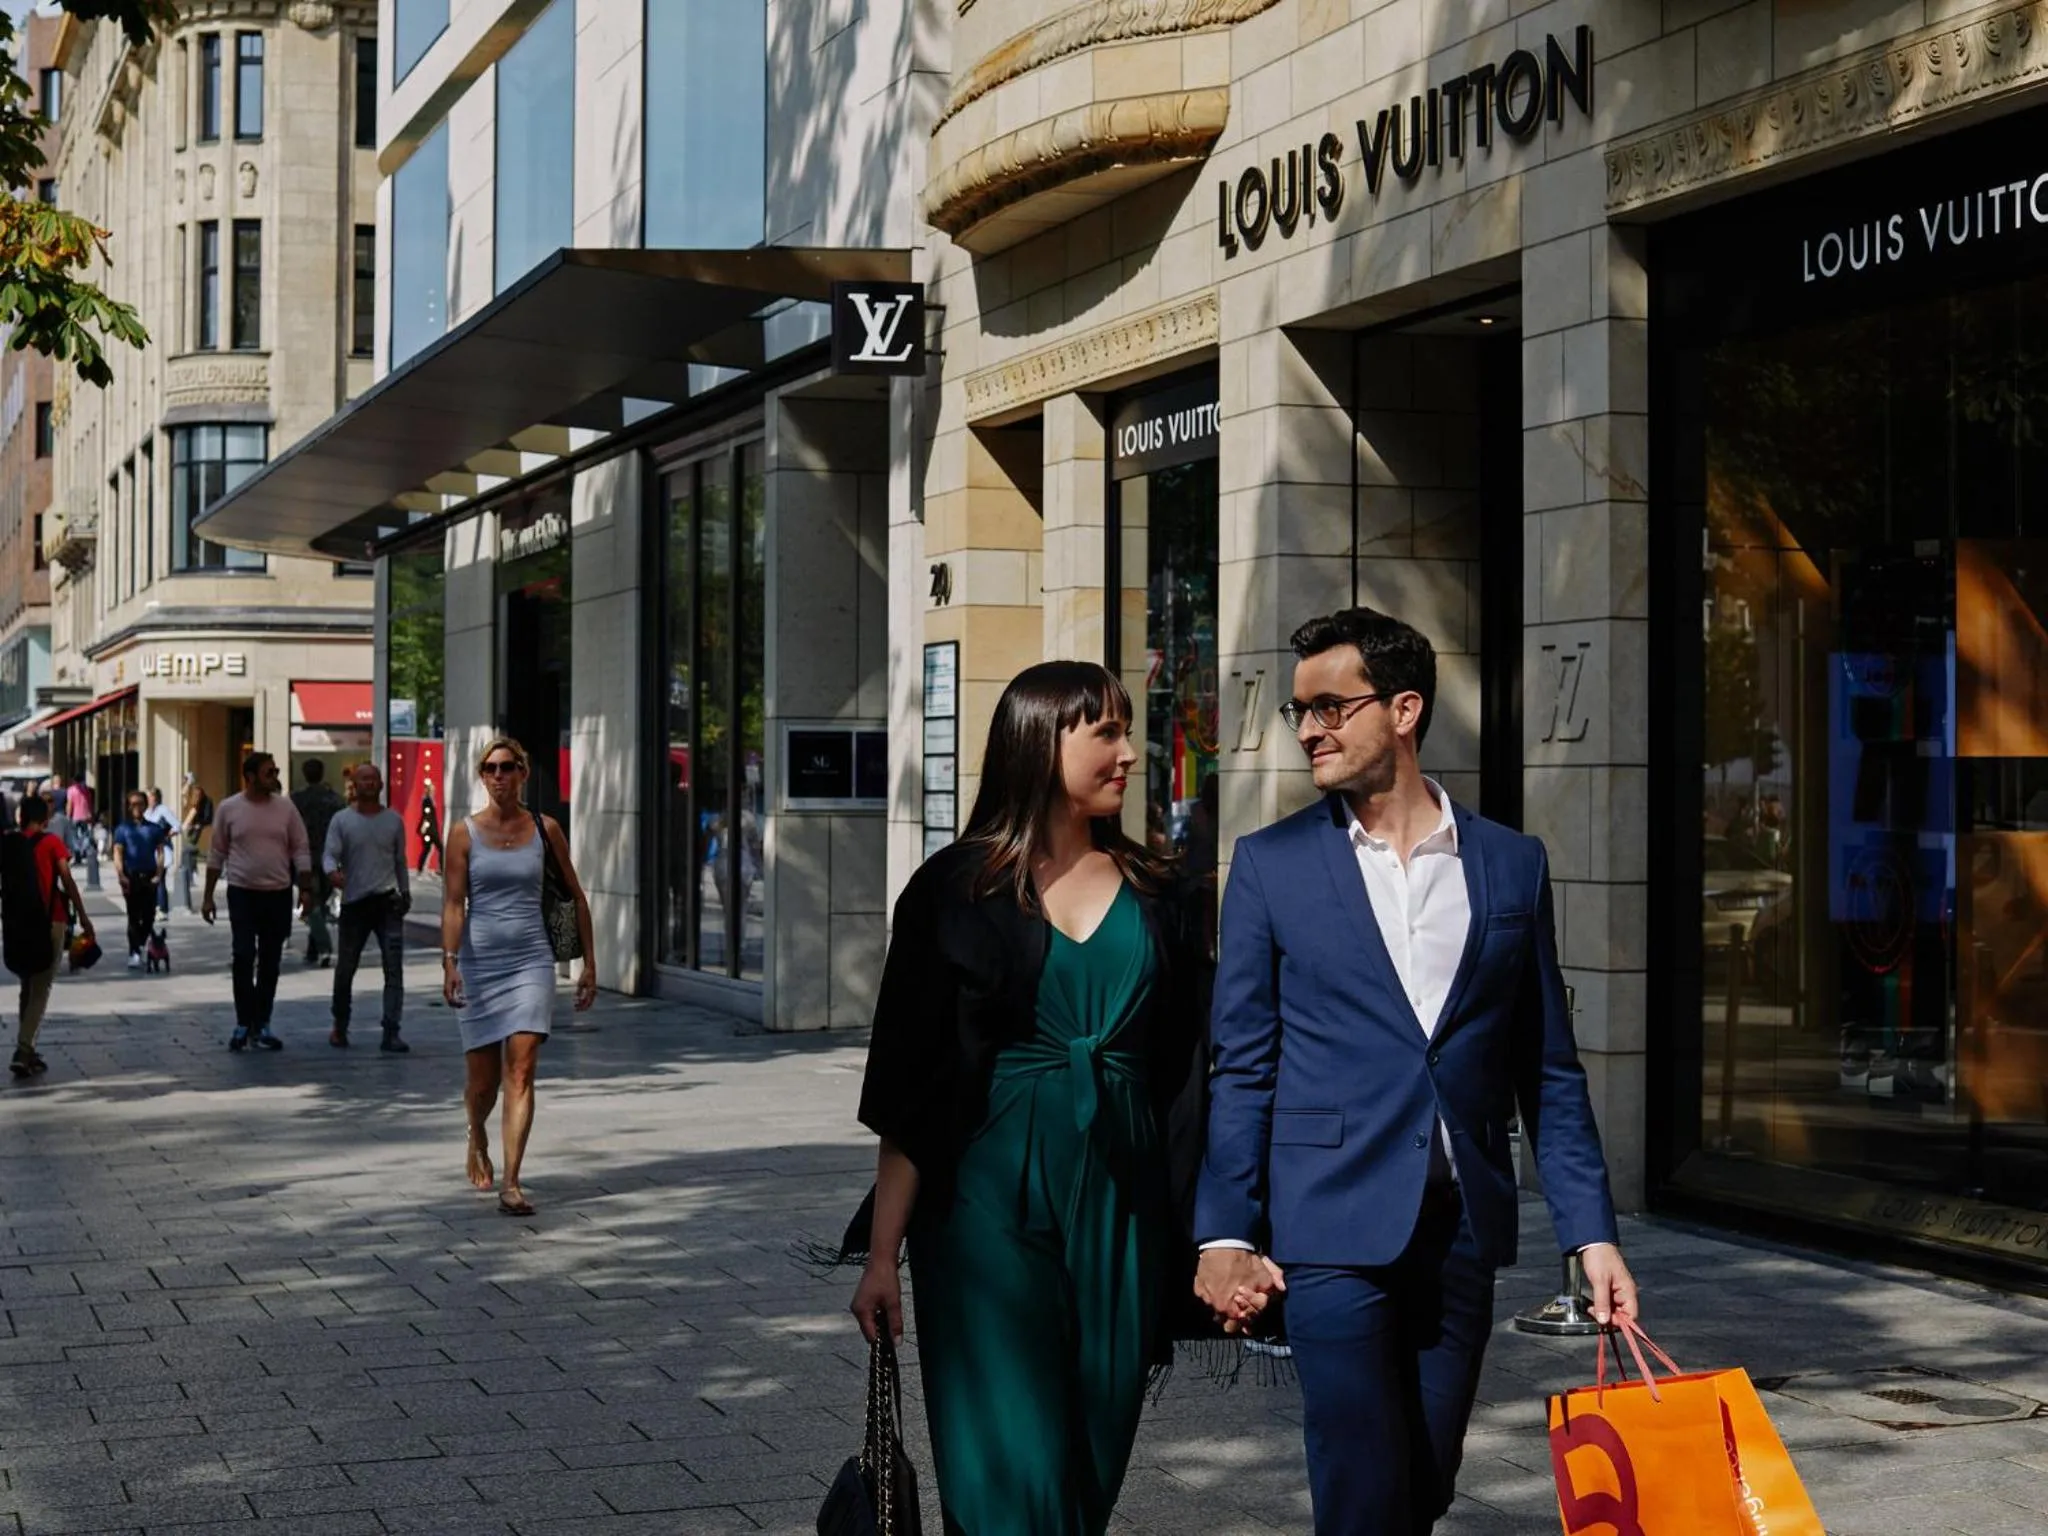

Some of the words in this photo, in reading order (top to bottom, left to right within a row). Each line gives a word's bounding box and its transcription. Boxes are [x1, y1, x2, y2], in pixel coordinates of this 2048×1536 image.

[1219, 132, 1344, 252] LOUIS
[1356, 24, 1593, 196] VUITTON
[1804, 213, 1905, 283] LOUIS
[1919, 172, 2048, 252] VUITTO
[1118, 417, 1163, 458] LOUIS
[141, 652, 246, 677] WEMPE
